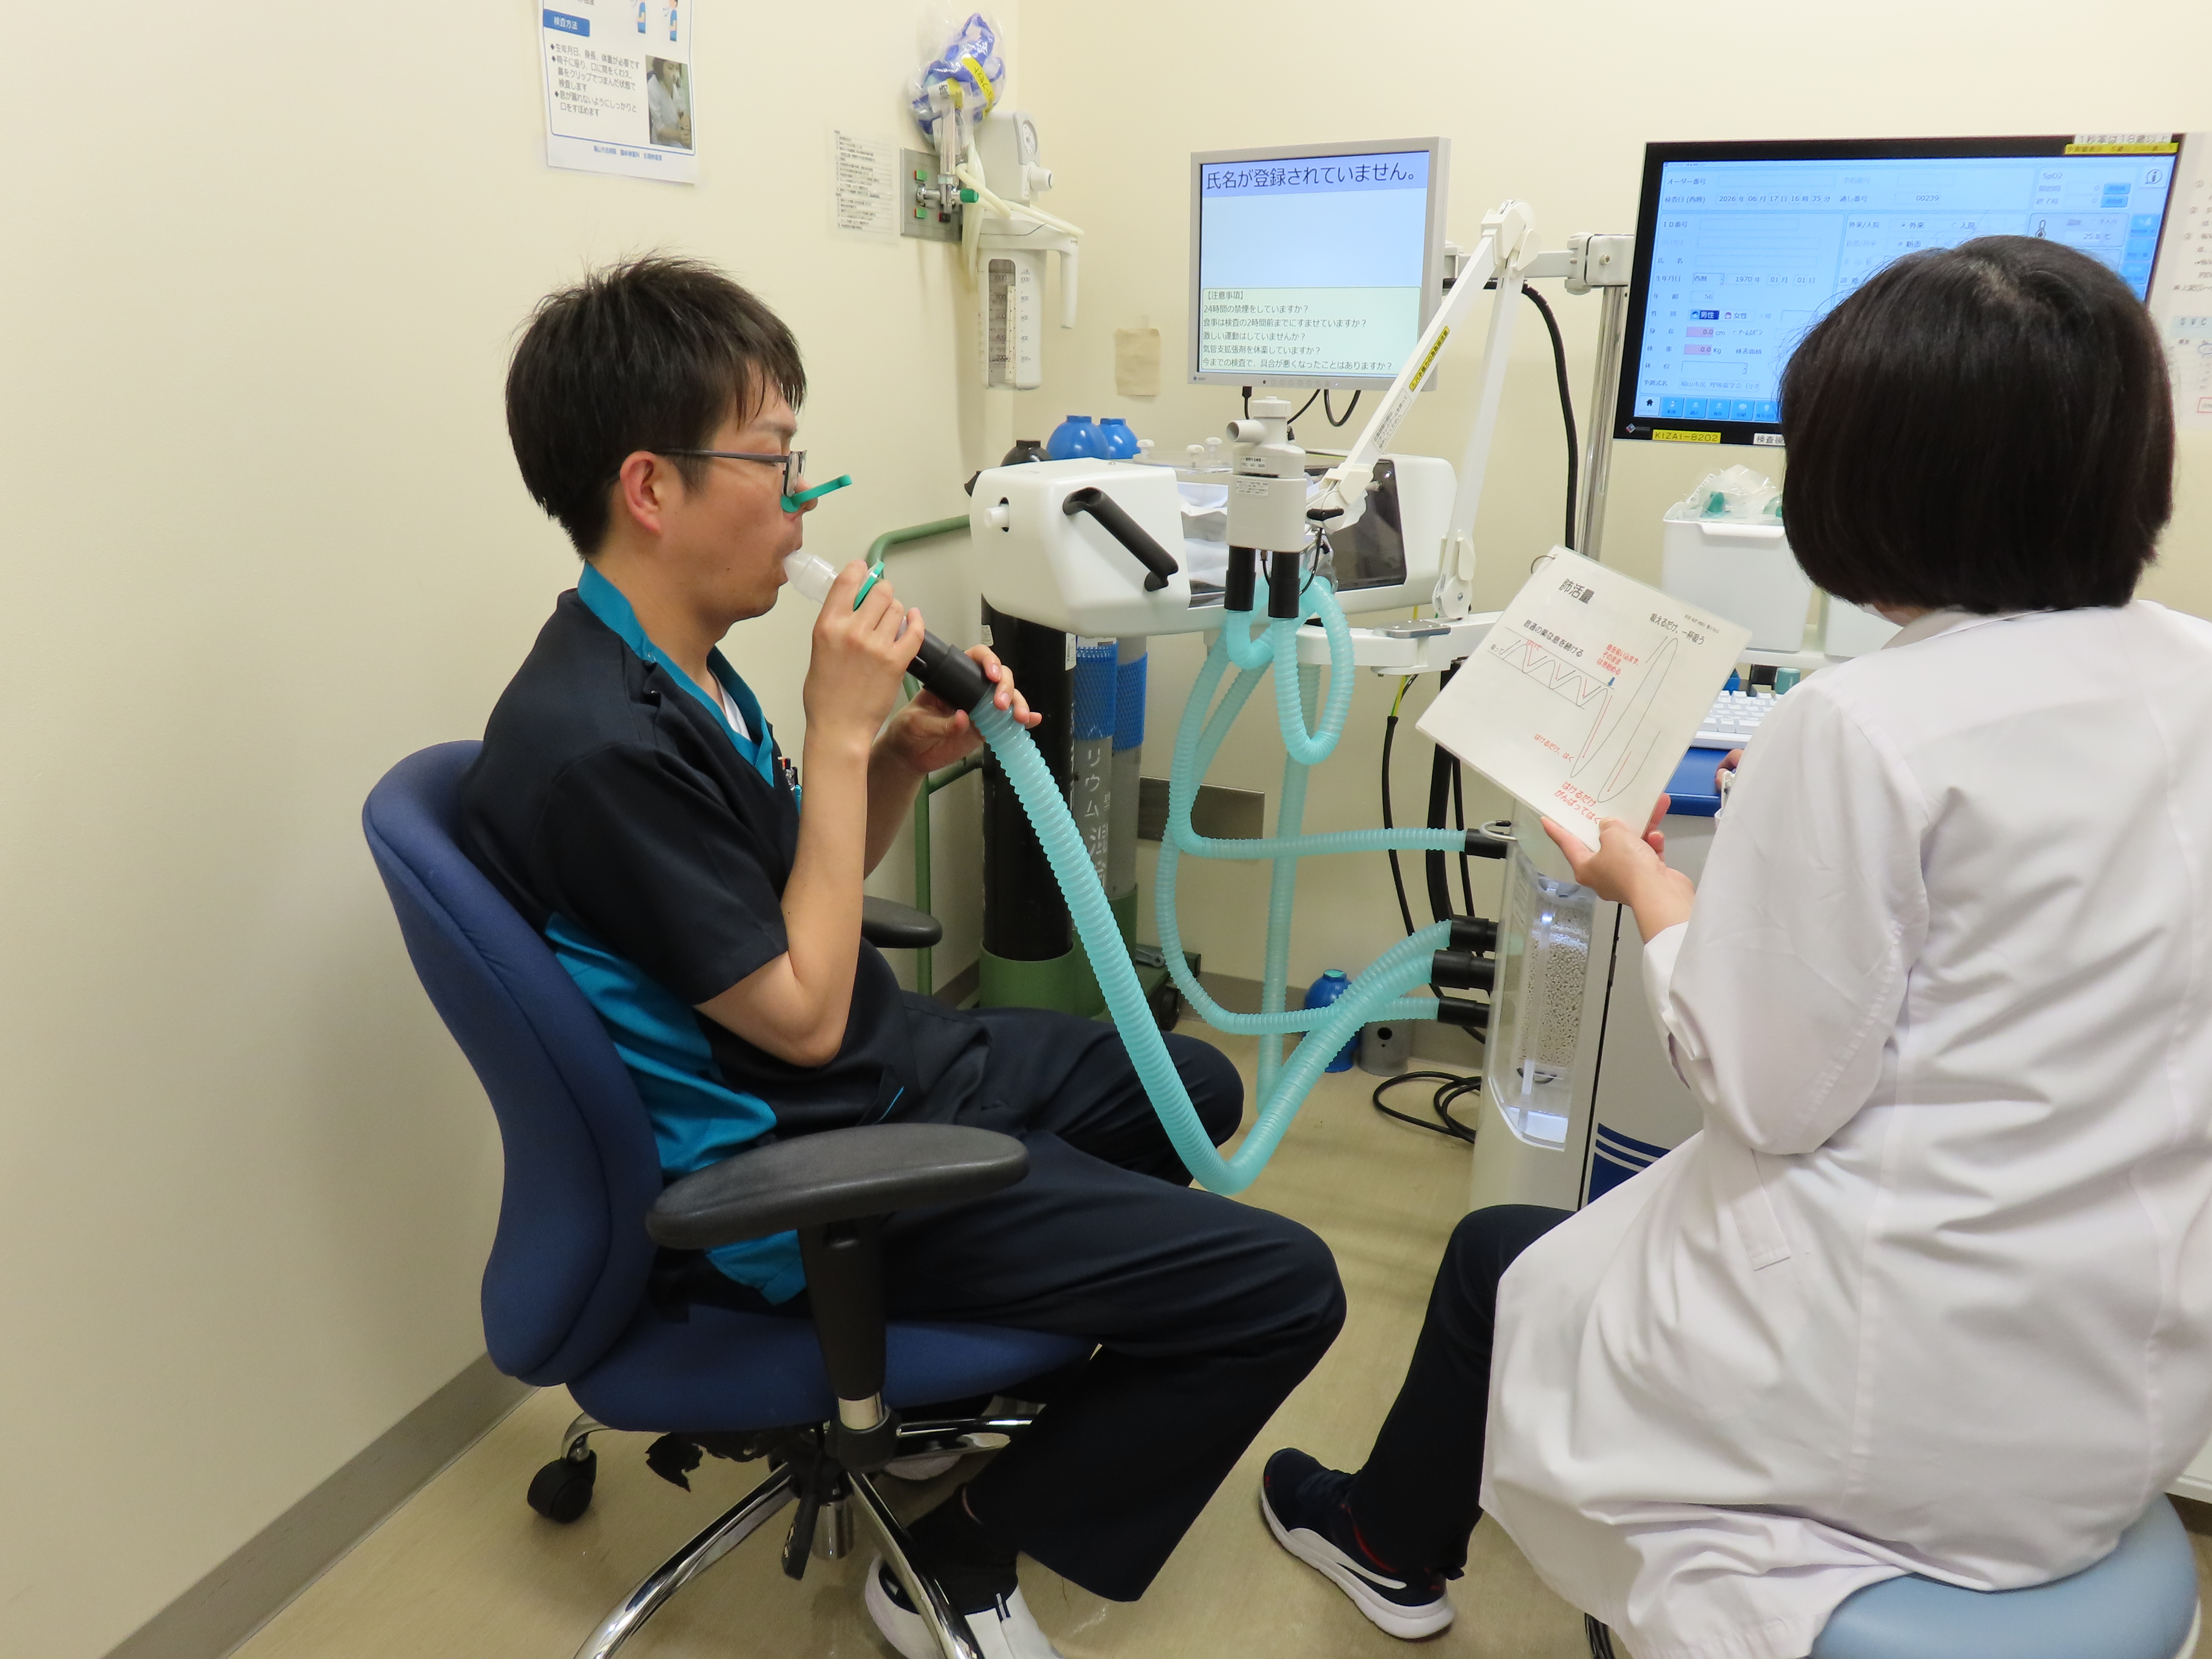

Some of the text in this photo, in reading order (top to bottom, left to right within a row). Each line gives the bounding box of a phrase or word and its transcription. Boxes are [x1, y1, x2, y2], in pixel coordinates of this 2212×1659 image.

[553, 16, 578, 30] 検査方法
[1206, 162, 1414, 190] 氏名が登録されていません。
[1208, 291, 1243, 300] 【注意事項】
[1203, 304, 1309, 314] 24時間の禁煙をしていますか？
[1700, 311, 1715, 319] 男性
[1203, 318, 1367, 328] 食事は検査の2時間前までにすませていますか？
[1202, 332, 1306, 341] 激しい運動はしていませんか？
[1202, 345, 1320, 355] 気管支拡張剤を休薬していますか？
[1202, 358, 1392, 370] 今までの検査で、具合が悪くなったことはありますか？
[1654, 432, 1719, 442] KIZAI-8202
[1558, 578, 1595, 604] 肺活量
[1650, 612, 1705, 645] 吸えるだけ、一杯吸う
[1523, 619, 1584, 658] 普通の楽な息を続ける
[1602, 651, 1622, 665] そのまま
[1596, 658, 1622, 675] はき始める
[1561, 781, 1597, 807] はけるだけ
[1554, 790, 1602, 824] がんばってはく
